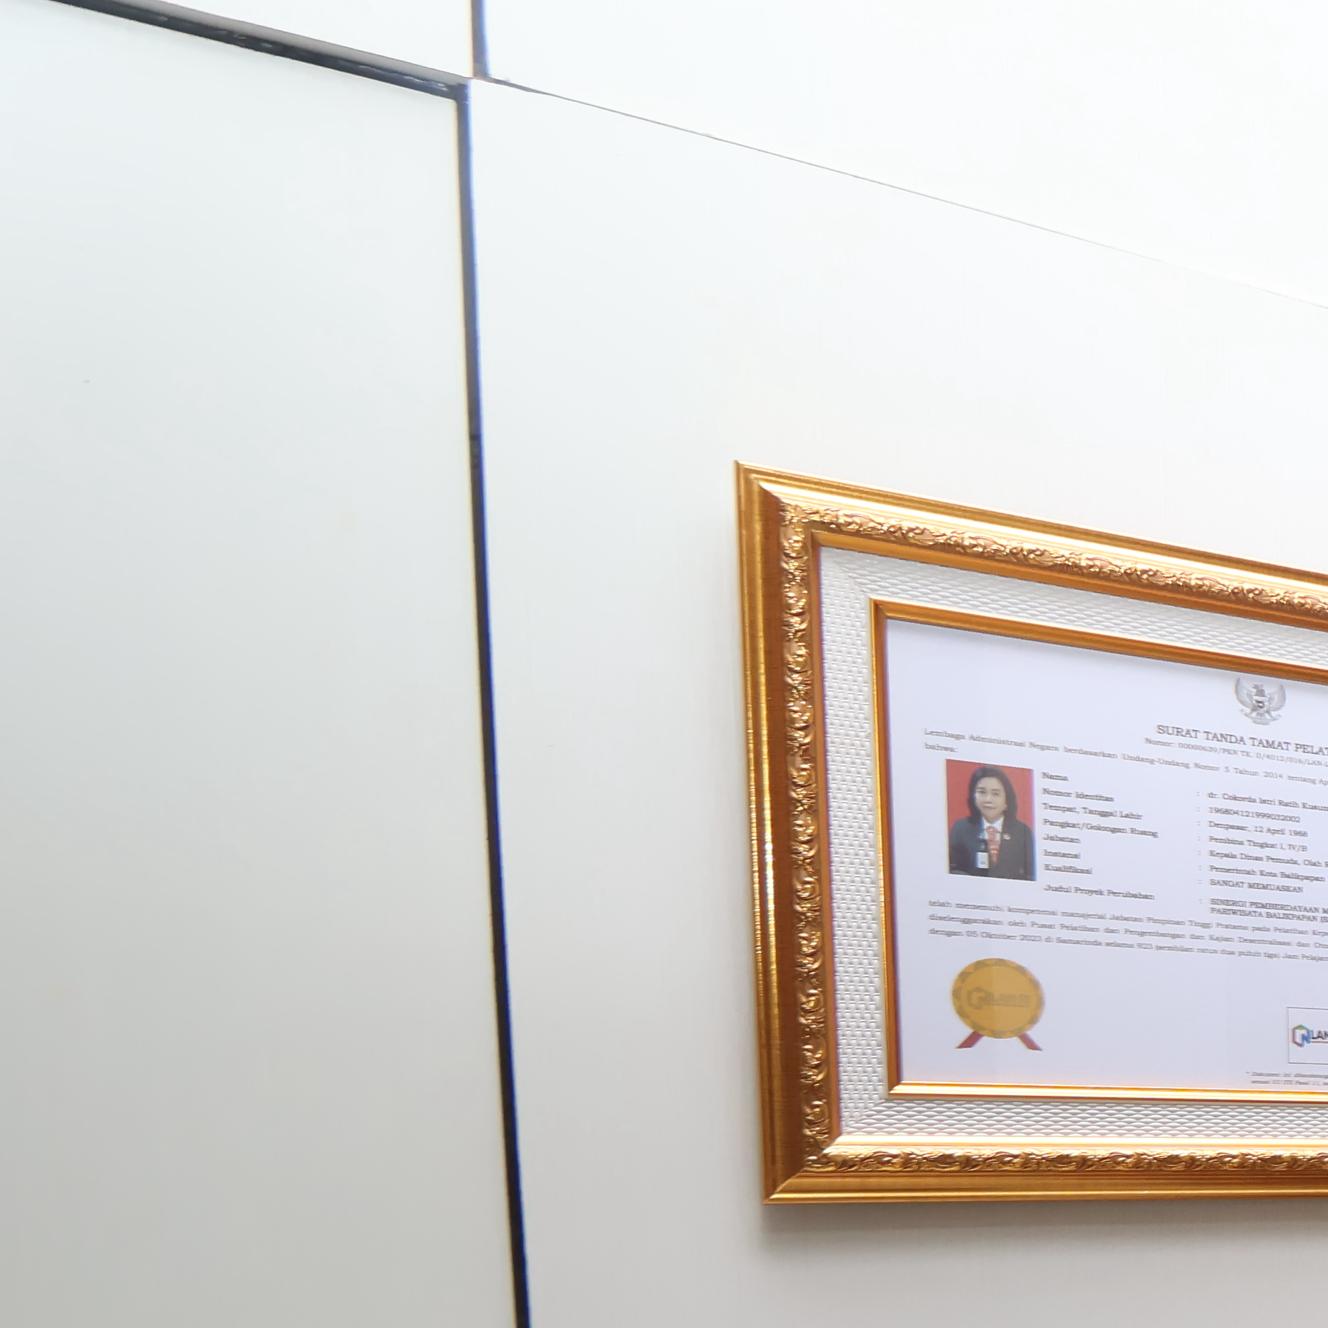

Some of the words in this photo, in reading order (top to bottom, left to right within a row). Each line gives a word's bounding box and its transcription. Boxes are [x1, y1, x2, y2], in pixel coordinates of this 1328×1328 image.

[1156, 724, 1200, 739] SURAT
[1203, 731, 1245, 745] TANDA
[1250, 737, 1290, 751] TAMAT
